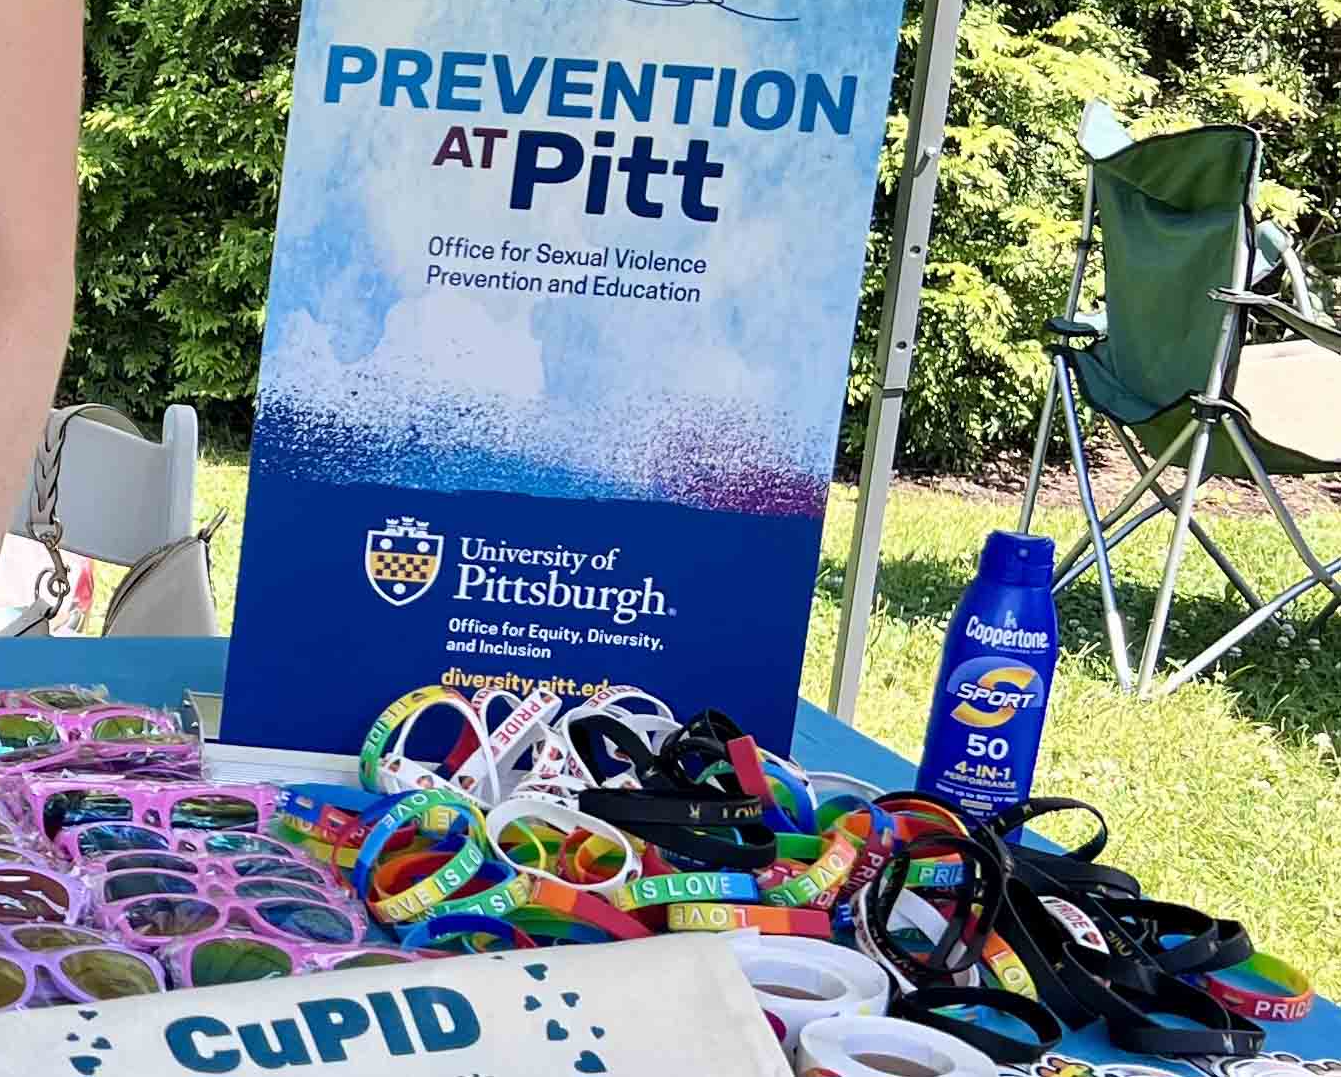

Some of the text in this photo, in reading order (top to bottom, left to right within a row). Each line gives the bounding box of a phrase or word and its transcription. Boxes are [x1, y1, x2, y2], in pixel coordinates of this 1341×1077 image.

[323, 43, 858, 136] PREVENTION
[431, 125, 724, 223] AT Pitt
[429, 235, 707, 274] Office for Sexual Violence
[426, 264, 701, 303] Prevention and Education
[460, 536, 620, 575] University of
[446, 639, 552, 659] and Inclusion
[449, 618, 664, 651] Office for Equity, Diversity,
[966, 616, 1049, 649] Coppertone
[441, 667, 609, 698] diversity.pitt.ed
[957, 682, 1036, 708] SPORT
[495, 701, 541, 746] PRIDE
[966, 733, 1009, 760] 50
[943, 770, 1016, 790] PERFORMANCE
[955, 761, 1011, 780] 4-IN-1
[386, 890, 434, 920] OVE
[435, 869, 462, 895] IS
[632, 875, 732, 902] IS LOVE
[165, 986, 481, 1074] CuPID
